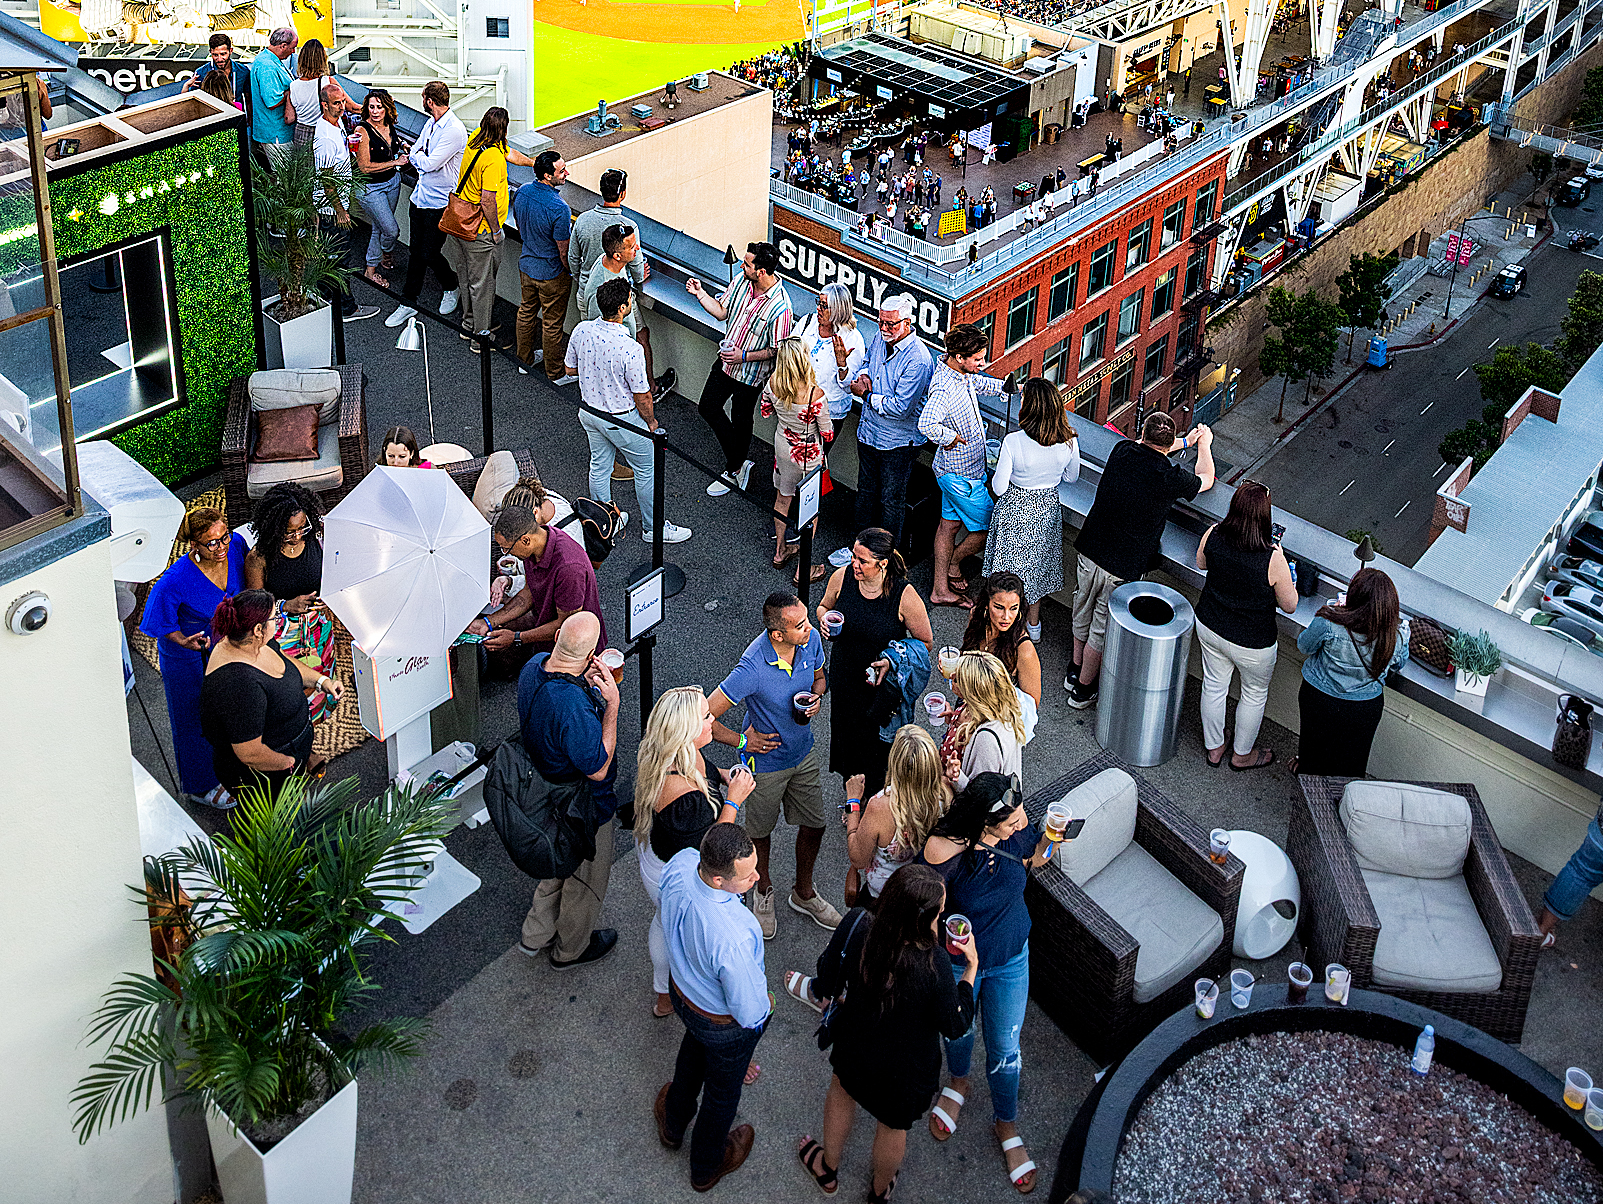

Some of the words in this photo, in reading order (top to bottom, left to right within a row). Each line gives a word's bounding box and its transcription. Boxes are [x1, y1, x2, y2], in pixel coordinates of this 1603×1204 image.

[778, 238, 889, 310] SUPPLY
[1100, 358, 1122, 378] SUPPLY
[633, 597, 659, 616] Entrance
